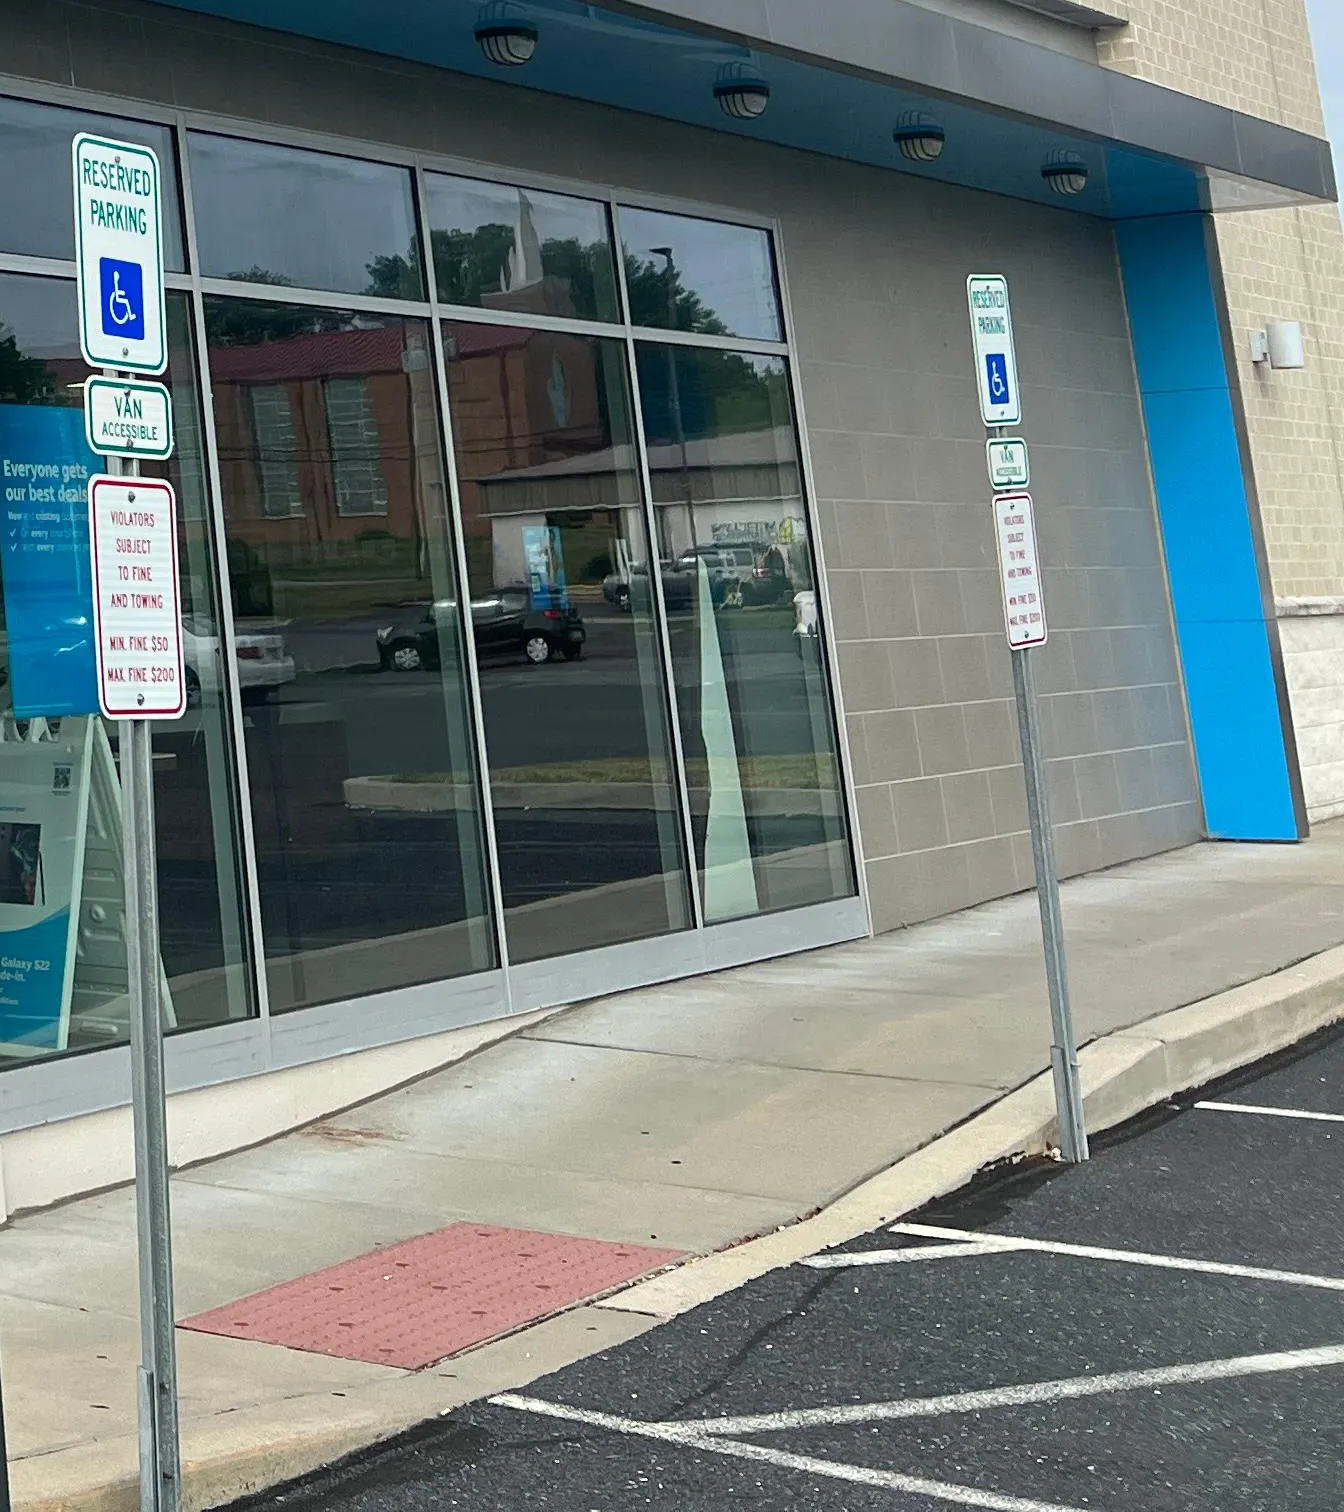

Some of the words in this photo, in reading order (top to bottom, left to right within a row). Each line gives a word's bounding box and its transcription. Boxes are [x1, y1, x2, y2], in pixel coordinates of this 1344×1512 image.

[83, 158, 151, 197] RESERVED
[90, 199, 147, 235] PARKING
[114, 395, 143, 420] VAN
[102, 421, 158, 441] ACCESSIBLE
[3, 459, 59, 482] Everyone
[61, 462, 88, 483] gets
[5, 487, 26, 502] our
[28, 483, 55, 502] best
[57, 484, 88, 503] deals
[110, 511, 155, 528] VIOLATORS
[116, 538, 151, 554] SUBJECT
[118, 566, 129, 581] TO
[132, 566, 153, 582] FINE
[111, 593, 128, 608] AND
[130, 593, 163, 609] TOWING
[129, 636, 148, 651] FINE
[152, 635, 168, 652] $50
[128, 667, 148, 683] FINE
[152, 666, 175, 684] $200
[1, 956, 32, 972] Galaxy
